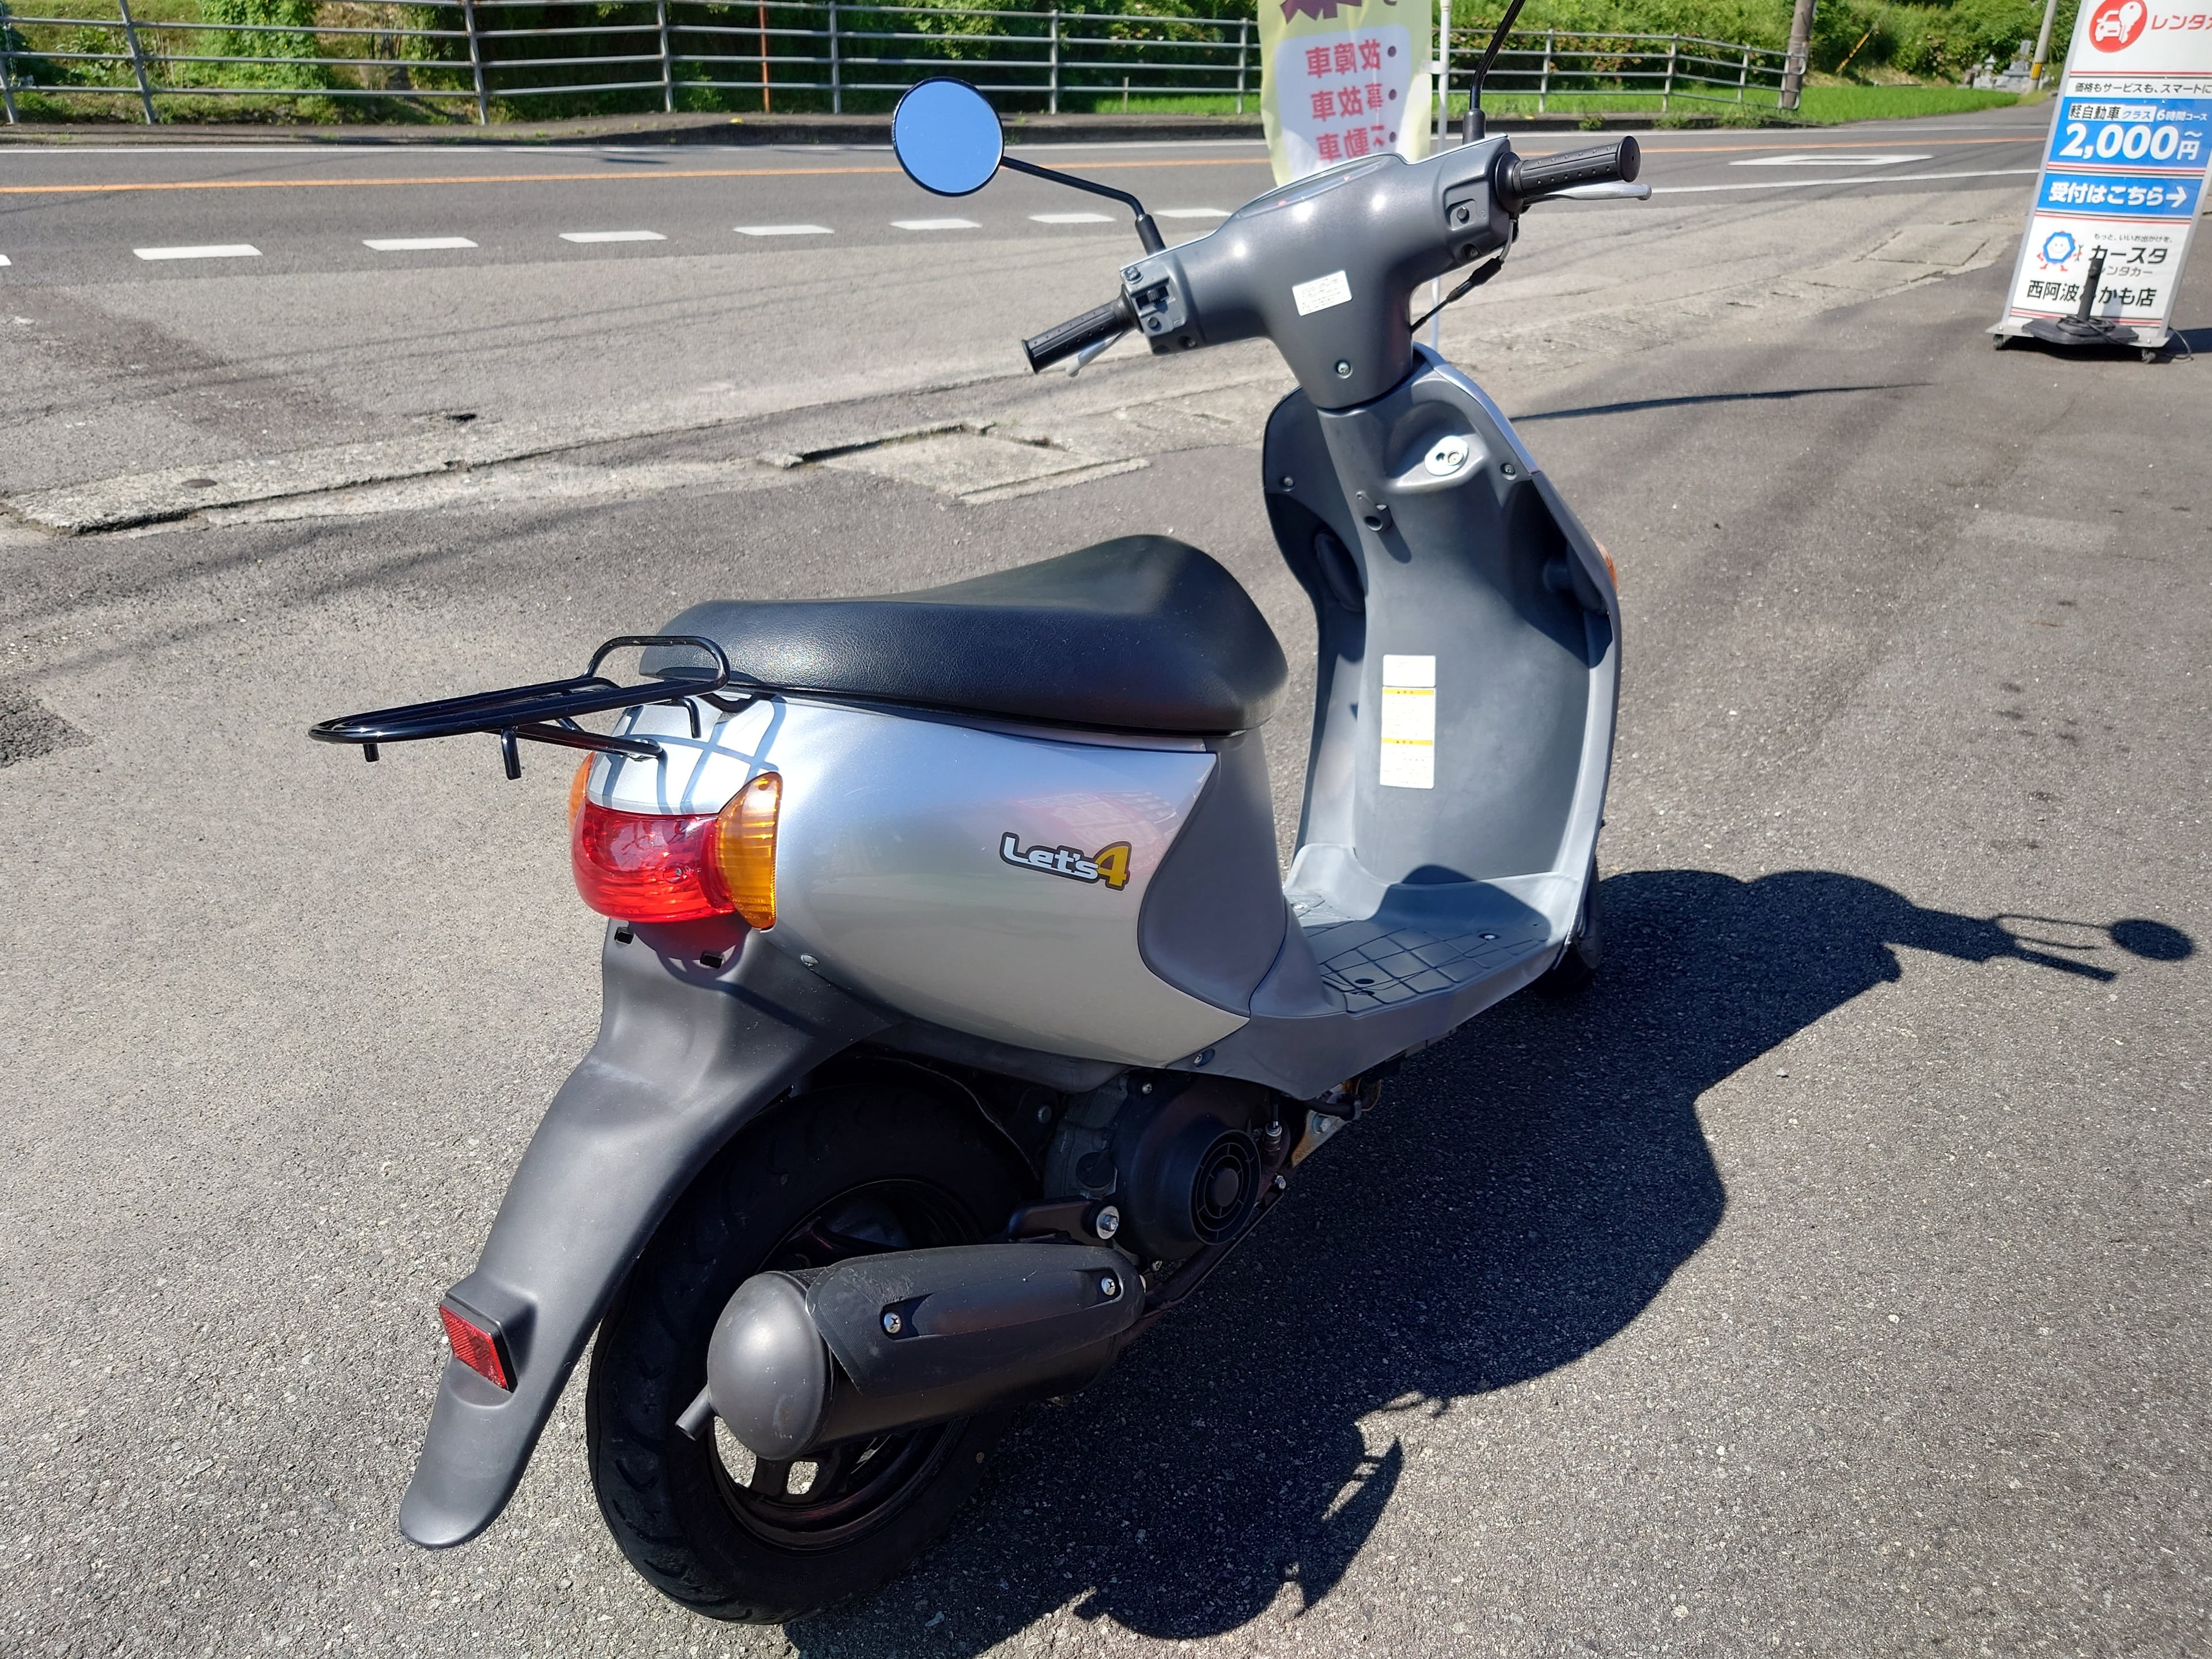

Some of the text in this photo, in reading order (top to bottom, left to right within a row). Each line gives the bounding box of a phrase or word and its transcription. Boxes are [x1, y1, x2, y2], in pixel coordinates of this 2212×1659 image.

[2048, 182, 2164, 207] 受付はこちら
[2089, 245, 2168, 264] カースタ
[2101, 266, 2153, 276] ンタカー
[2027, 280, 2157, 307] 西阿波かも店
